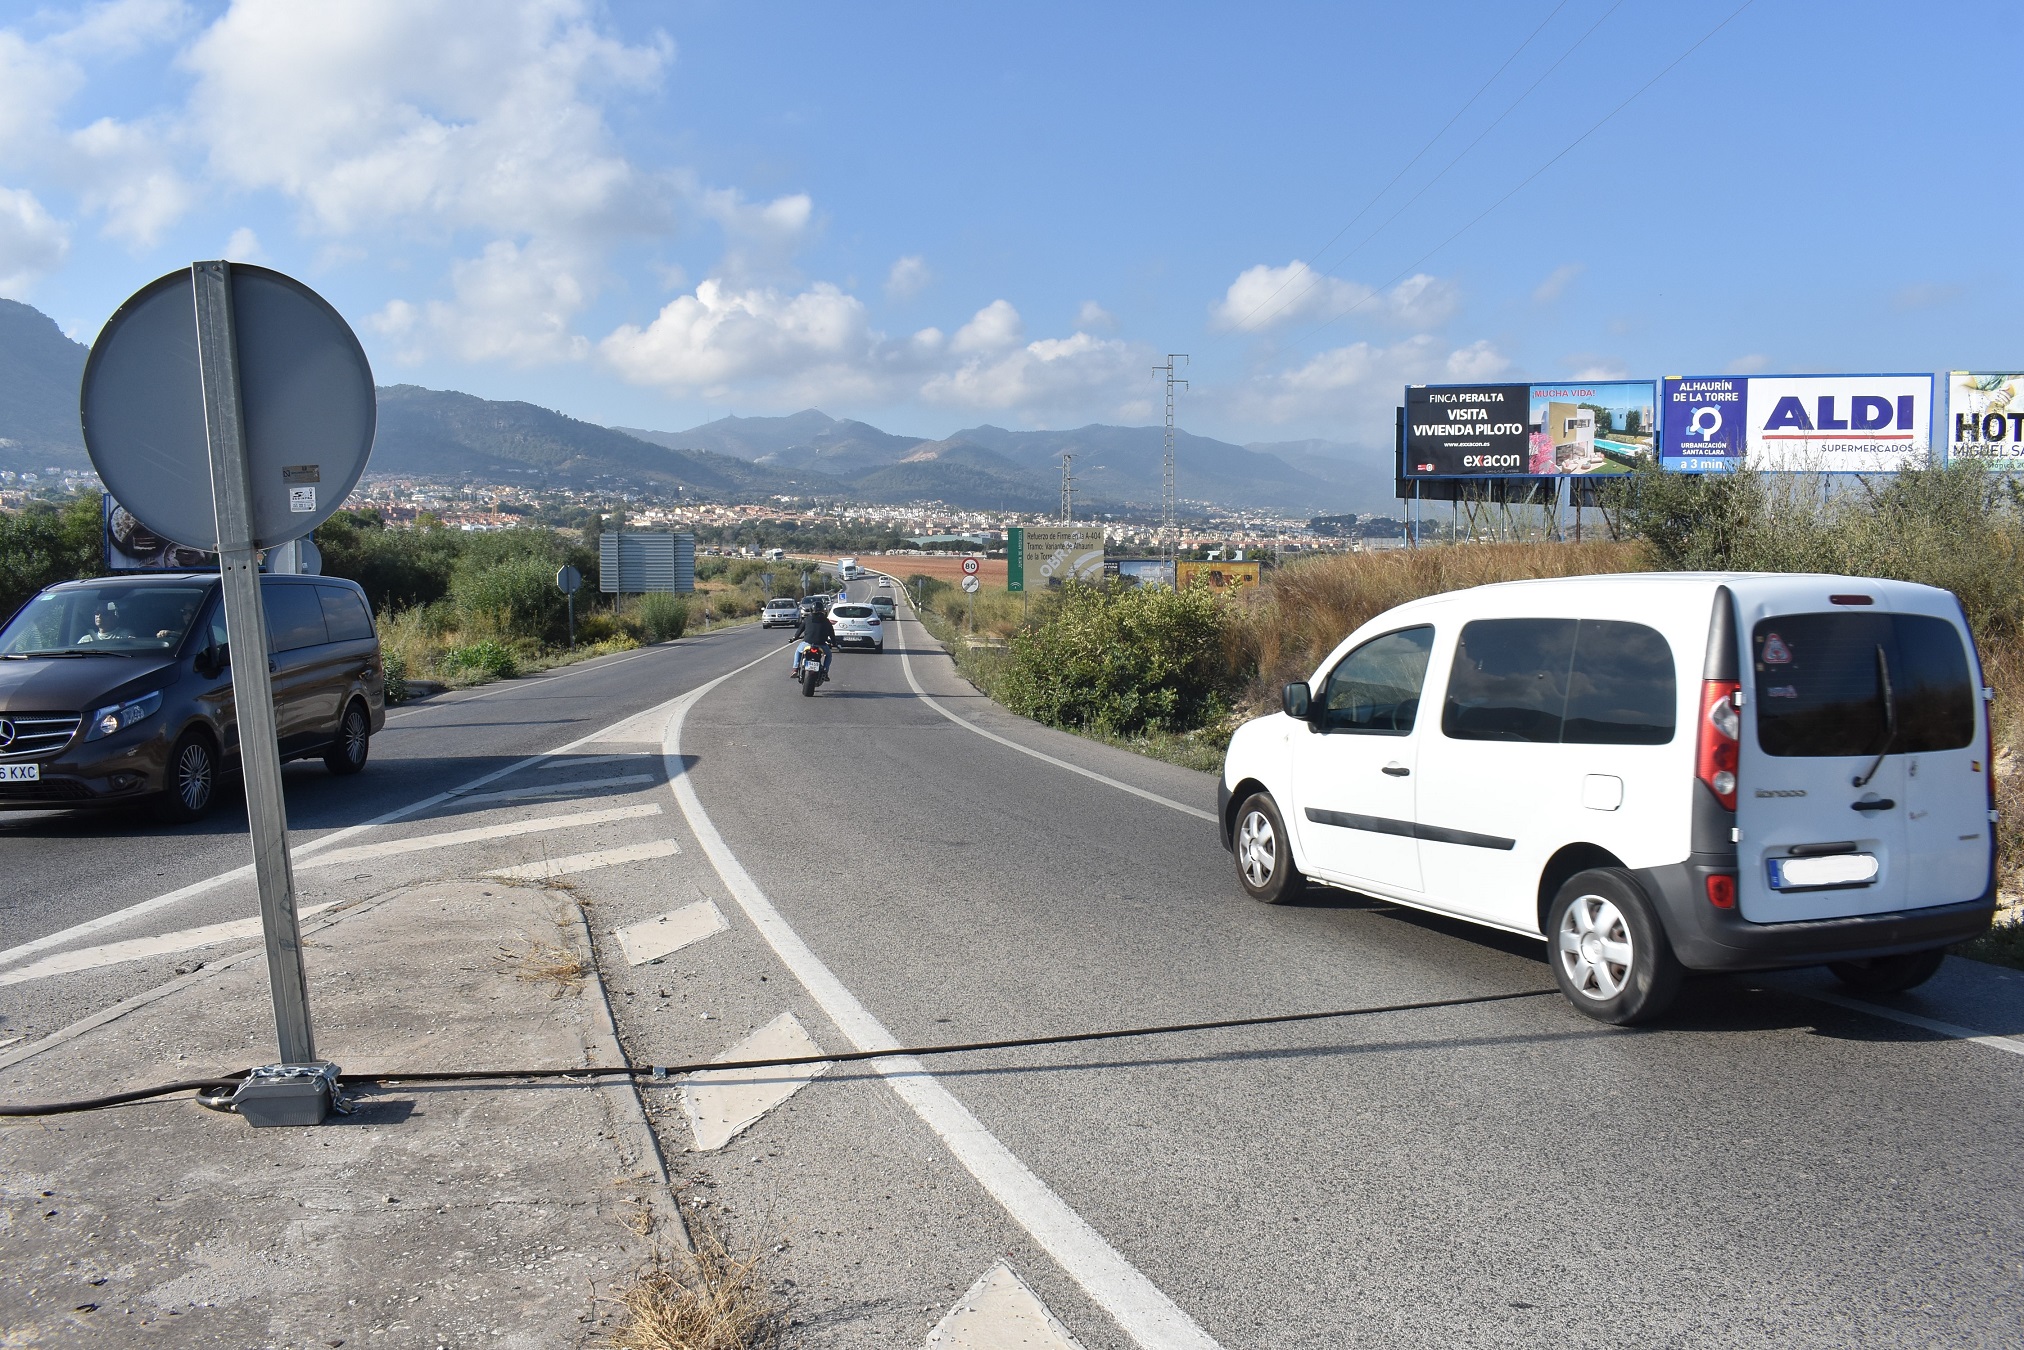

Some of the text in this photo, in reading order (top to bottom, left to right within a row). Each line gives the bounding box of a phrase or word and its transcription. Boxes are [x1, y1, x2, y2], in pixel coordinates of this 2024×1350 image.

[1680, 380, 1732, 391] ALHAURÍN
[1429, 393, 1504, 402] FINCA PERALTA
[1532, 389, 1595, 399] ¡MUCHA VIDA!
[1673, 392, 1739, 401] DE LA TORRE
[1447, 408, 1488, 420] VISITA
[1763, 395, 1914, 430] ALDI
[1413, 423, 1523, 436] VIVIENDA PILOTO
[1681, 441, 1727, 449] URBANIZACIÓN
[1821, 444, 1913, 452] SUPERMERCADOS
[1680, 461, 1687, 469] a
[1690, 459, 1698, 469] 3
[1027, 532, 1049, 540] Refuerzo
[1057, 532, 1071, 540] Firme
[1086, 532, 1101, 540] A-404
[1045, 542, 1065, 550] Variante
[1026, 552, 1033, 560] de
[11, 766, 36, 779] KXC
